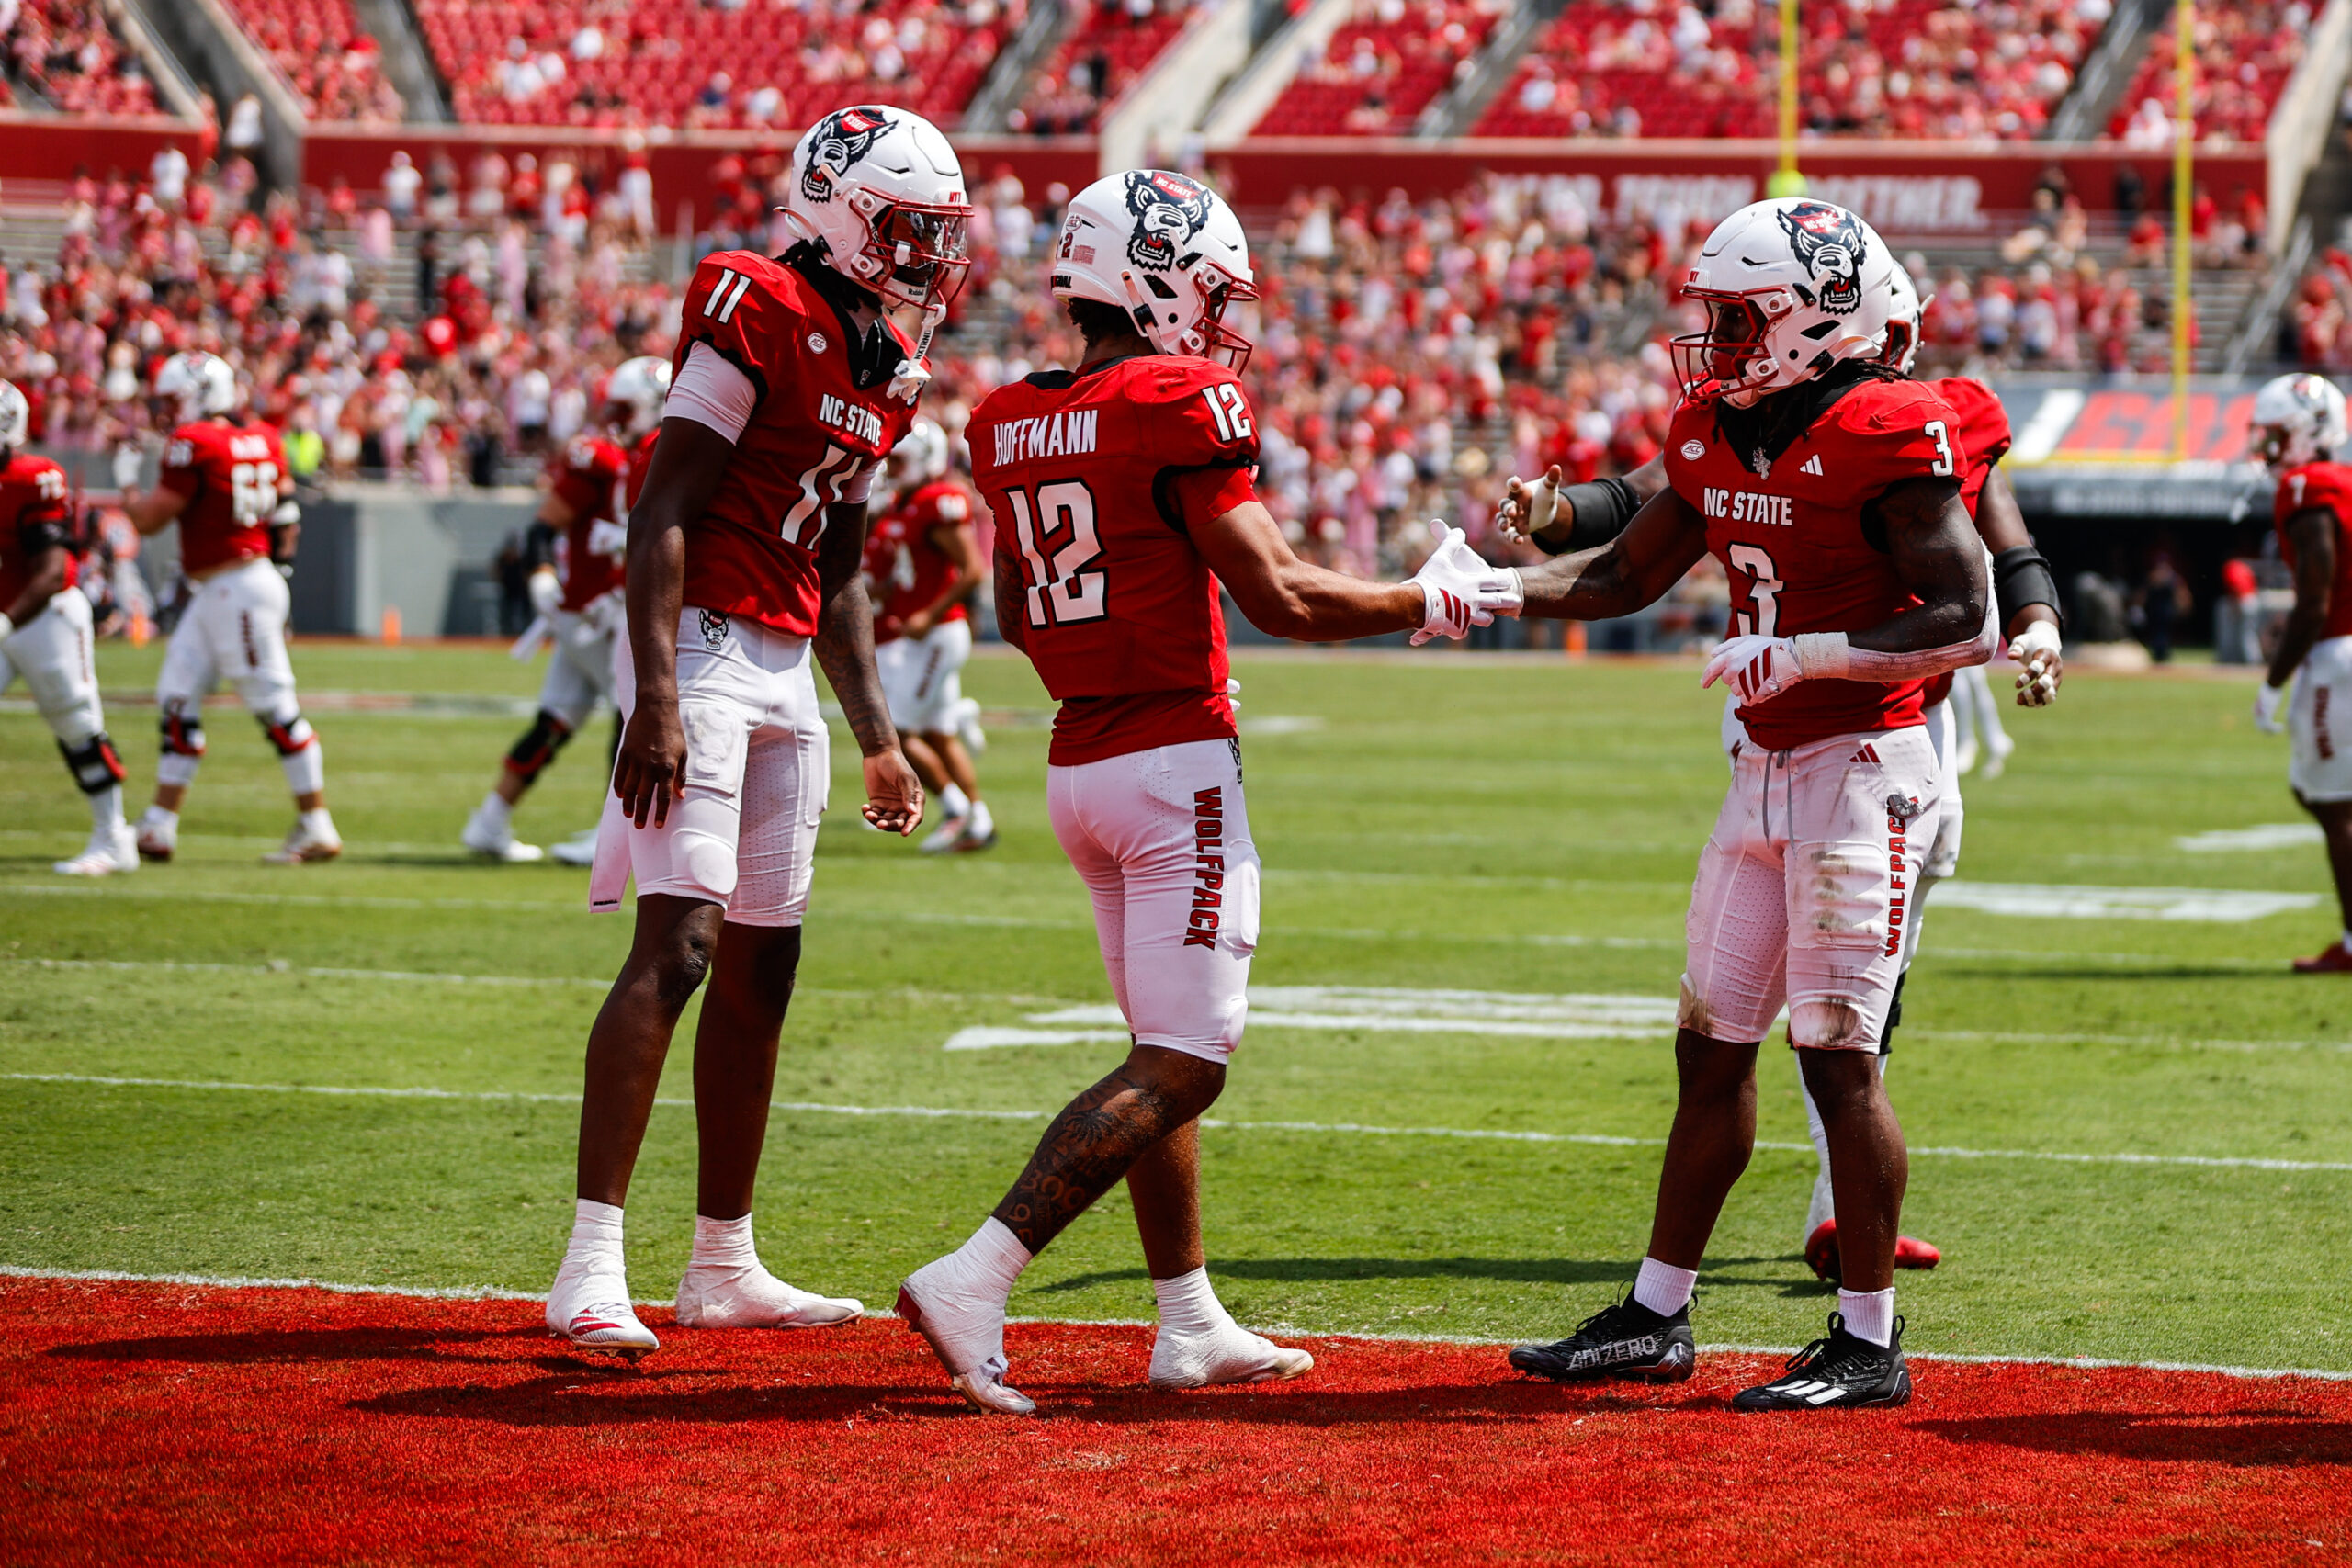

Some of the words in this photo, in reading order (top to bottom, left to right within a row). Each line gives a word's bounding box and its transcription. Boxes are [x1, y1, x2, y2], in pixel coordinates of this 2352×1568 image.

[1155, 176, 1169, 187] NC
[1168, 183, 1193, 197] STATE
[703, 268, 752, 323] 11
[819, 393, 843, 427] NC
[845, 404, 883, 447] STATE
[993, 409, 1098, 467] HOFFMANN
[1201, 382, 1252, 443] 12
[1923, 420, 1954, 478] 3
[1703, 487, 1727, 518] NC
[1731, 491, 1792, 526] STATE
[1002, 477, 1109, 630] 12
[1727, 542, 1786, 637] 3
[1182, 785, 1225, 952] WOLFPACK
[1885, 805, 1907, 957] WOLFPAC
